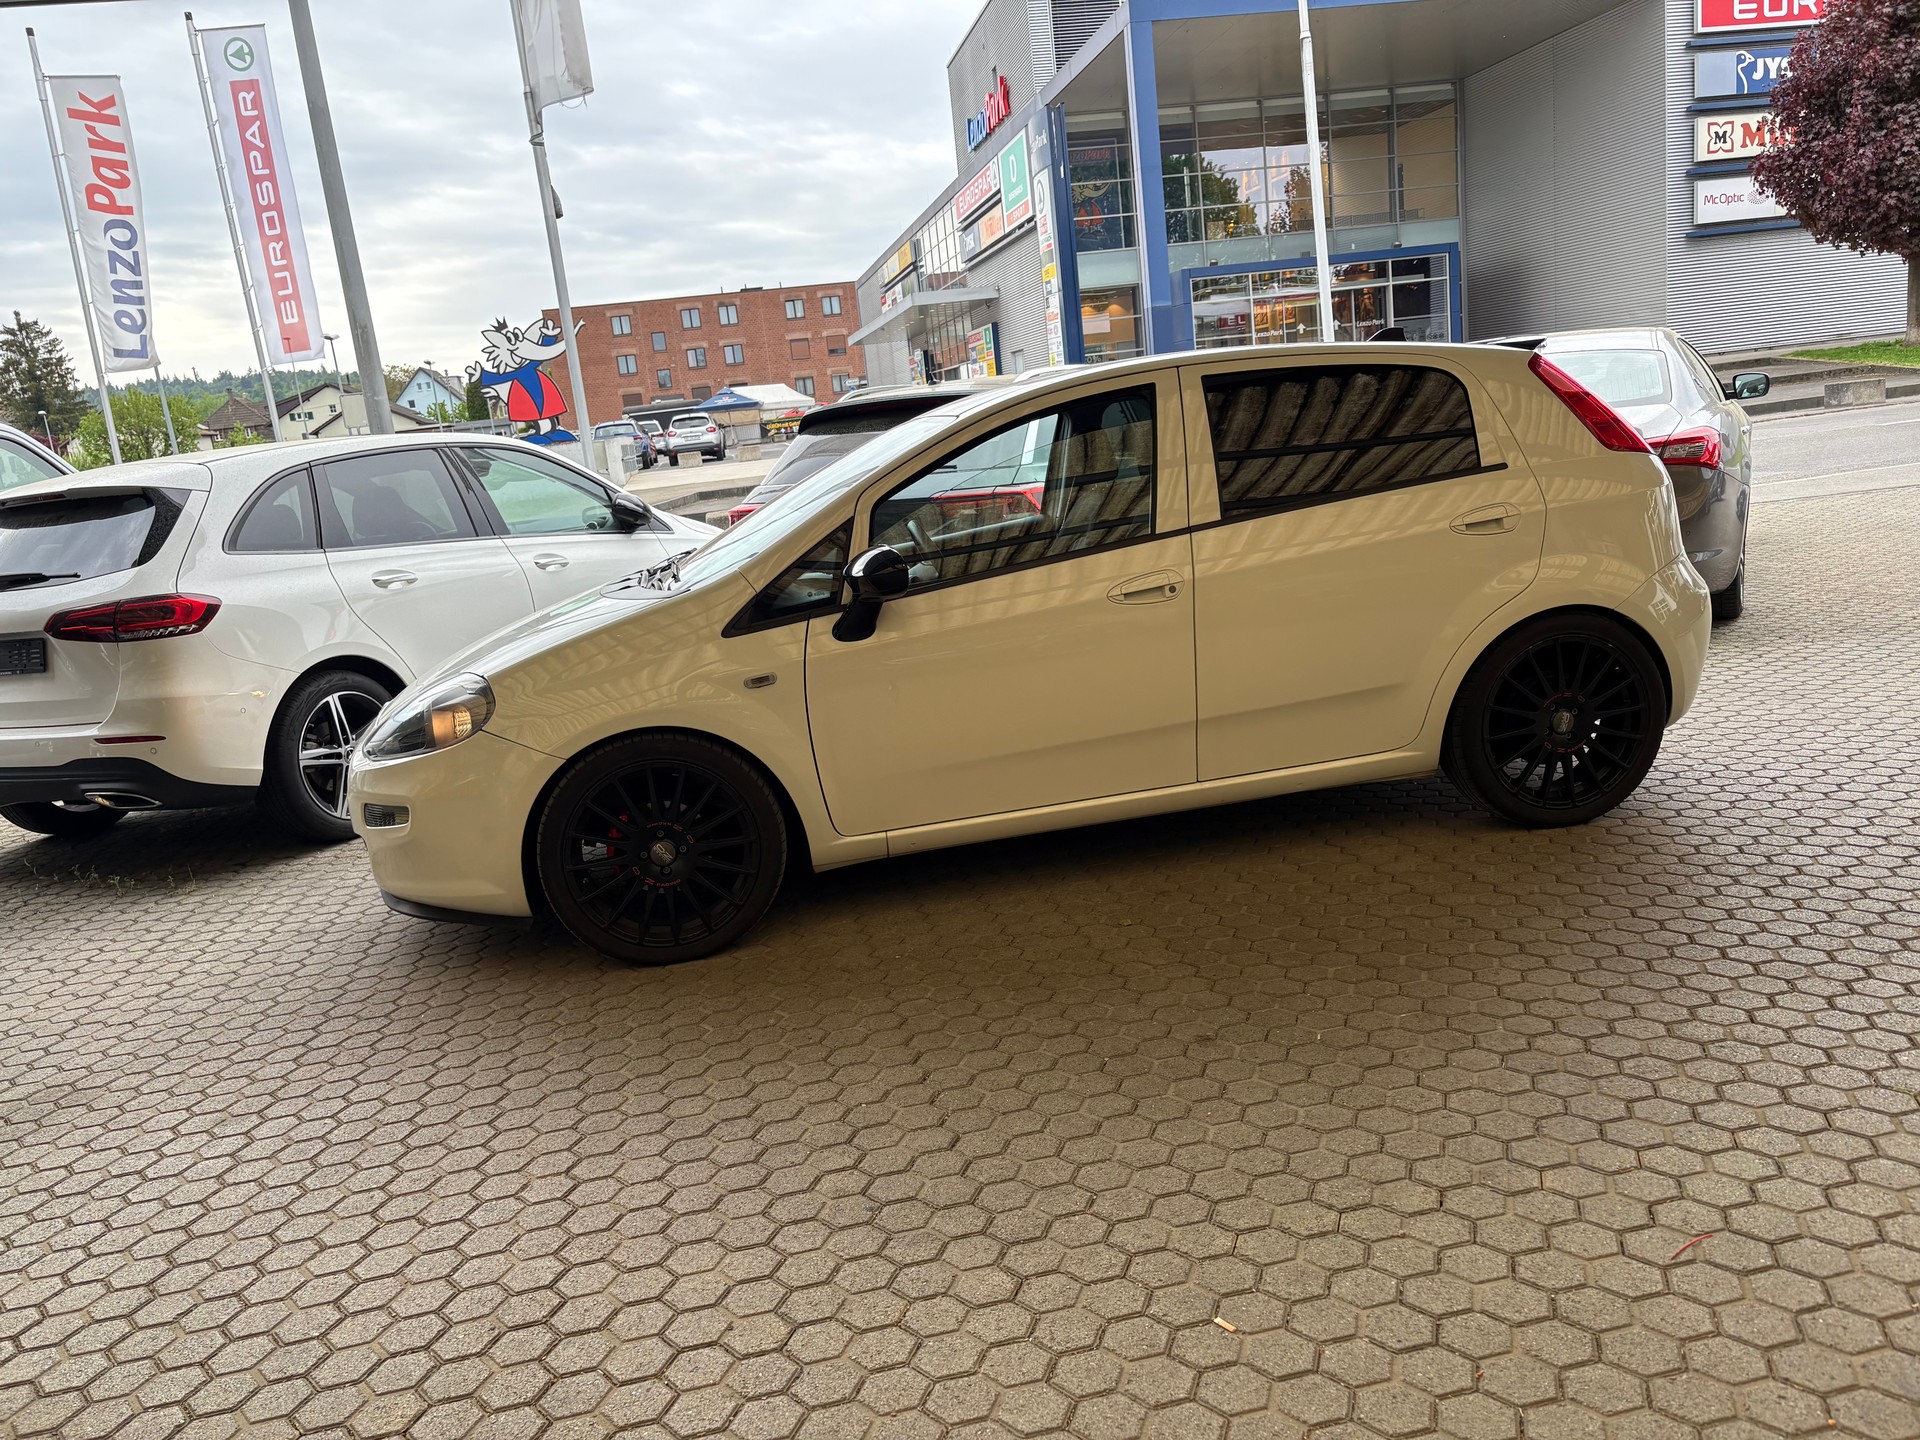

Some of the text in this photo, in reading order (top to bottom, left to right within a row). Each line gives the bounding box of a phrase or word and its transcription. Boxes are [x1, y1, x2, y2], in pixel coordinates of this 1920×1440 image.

[1752, 56, 1793, 80] JYS
[66, 91, 149, 360] LenzoPark
[238, 90, 300, 325] EUROSPAR
[958, 169, 994, 215] EUROSPAR
